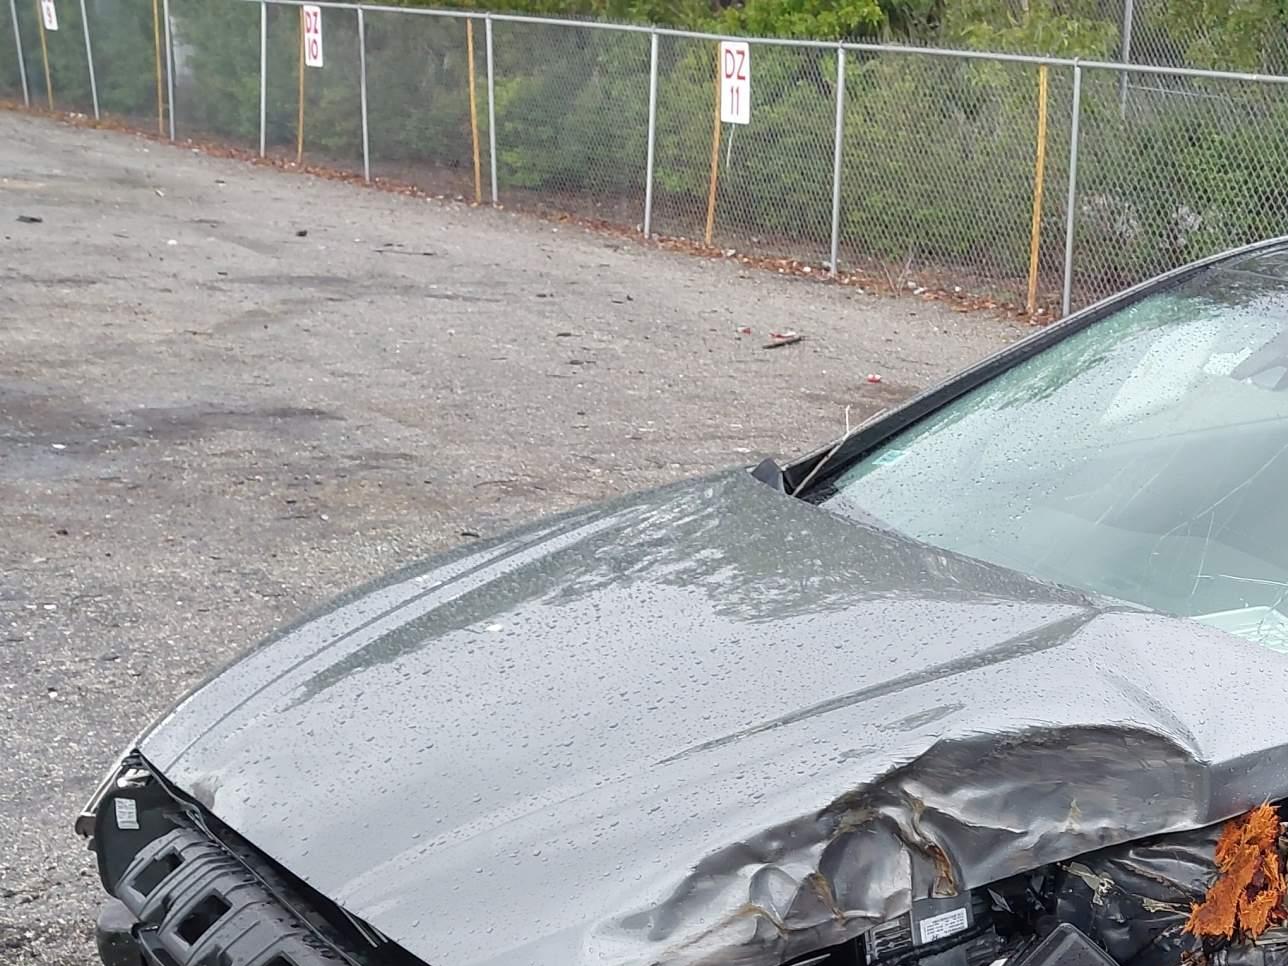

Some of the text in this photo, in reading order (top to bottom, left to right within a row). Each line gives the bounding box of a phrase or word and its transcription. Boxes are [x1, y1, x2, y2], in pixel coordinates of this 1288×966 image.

[305, 11, 318, 34] DZ
[308, 38, 318, 60] 10
[725, 49, 746, 80] DZ
[730, 86, 739, 116] 11
